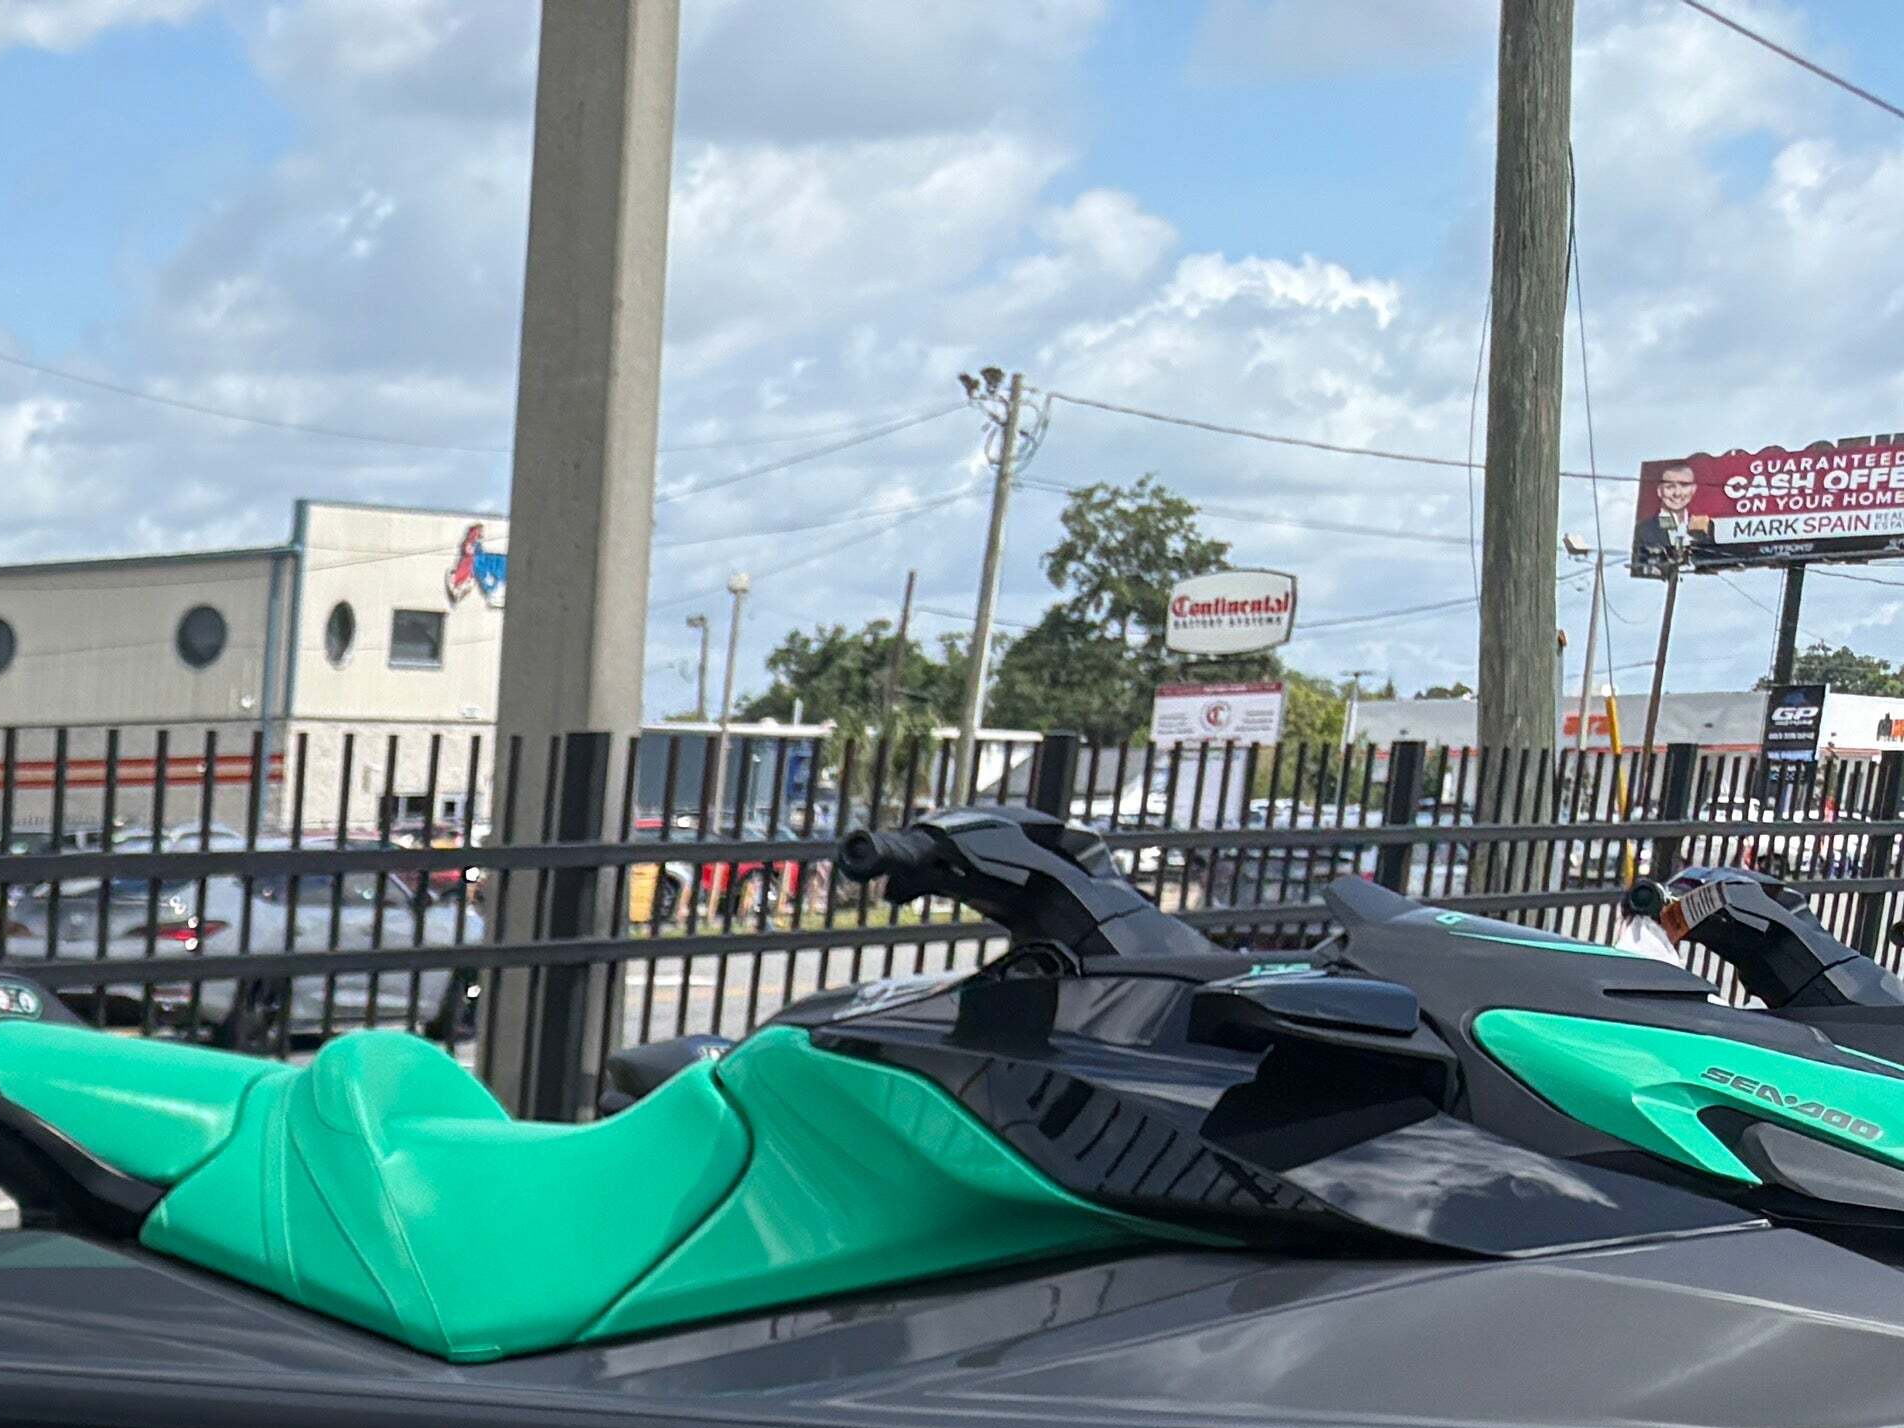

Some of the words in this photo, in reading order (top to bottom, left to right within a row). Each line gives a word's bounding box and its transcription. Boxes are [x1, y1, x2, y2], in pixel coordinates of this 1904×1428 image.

[1749, 451, 1904, 475] GUARANTEED
[1723, 471, 1816, 499] CASH
[1736, 499, 1767, 513] ON
[1775, 494, 1835, 511] YOUR
[1842, 490, 1904, 506] HOME
[1732, 518, 1799, 538] MARK
[1802, 514, 1872, 534] SPAIN
[1171, 591, 1290, 617] Continental
[1771, 706, 1819, 721] GP
